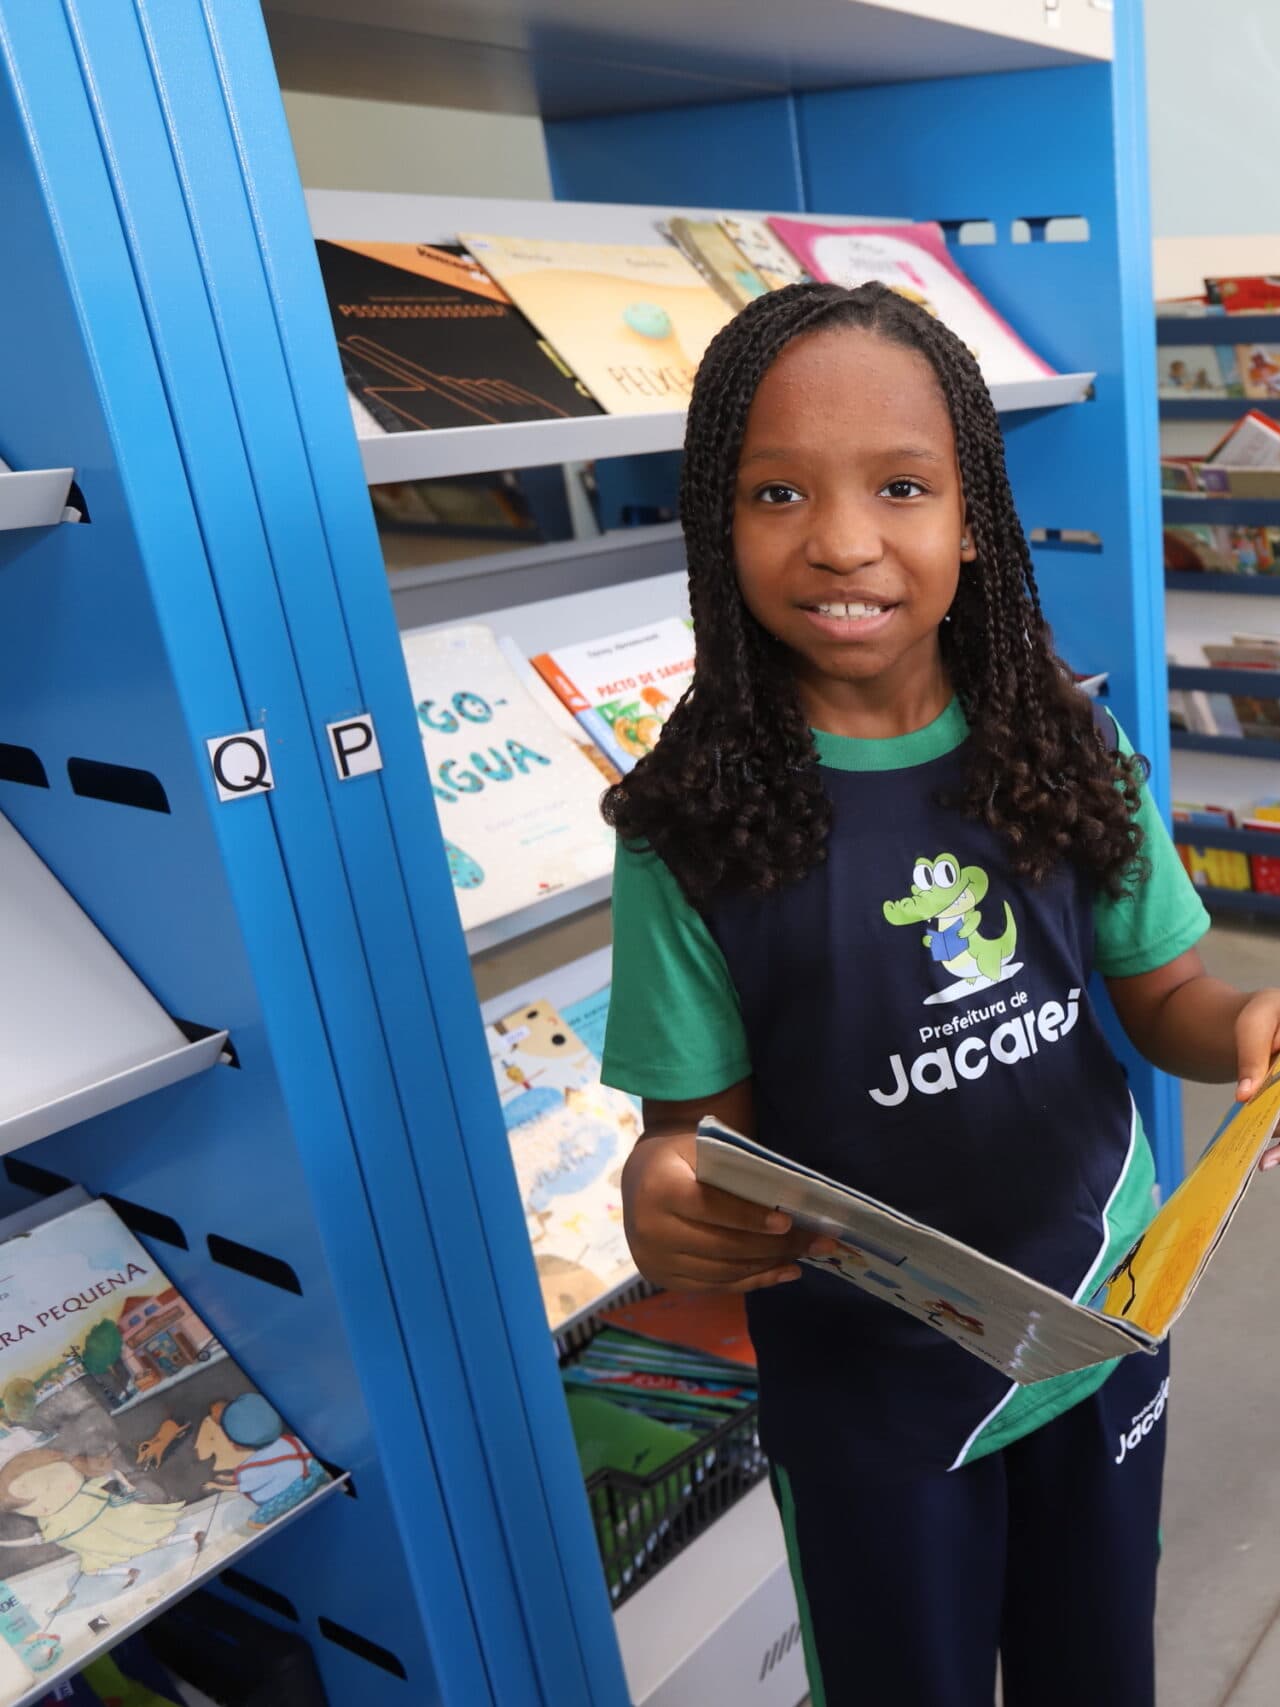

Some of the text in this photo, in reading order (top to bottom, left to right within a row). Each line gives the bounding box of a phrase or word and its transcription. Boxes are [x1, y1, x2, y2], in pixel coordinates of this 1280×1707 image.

[597, 677, 637, 697] PACTO
[638, 671, 656, 685] DE
[213, 736, 272, 792] Q
[332, 722, 373, 777] P
[919, 991, 1029, 1043] Prefeitura de
[36, 1262, 149, 1328] PEQUENA
